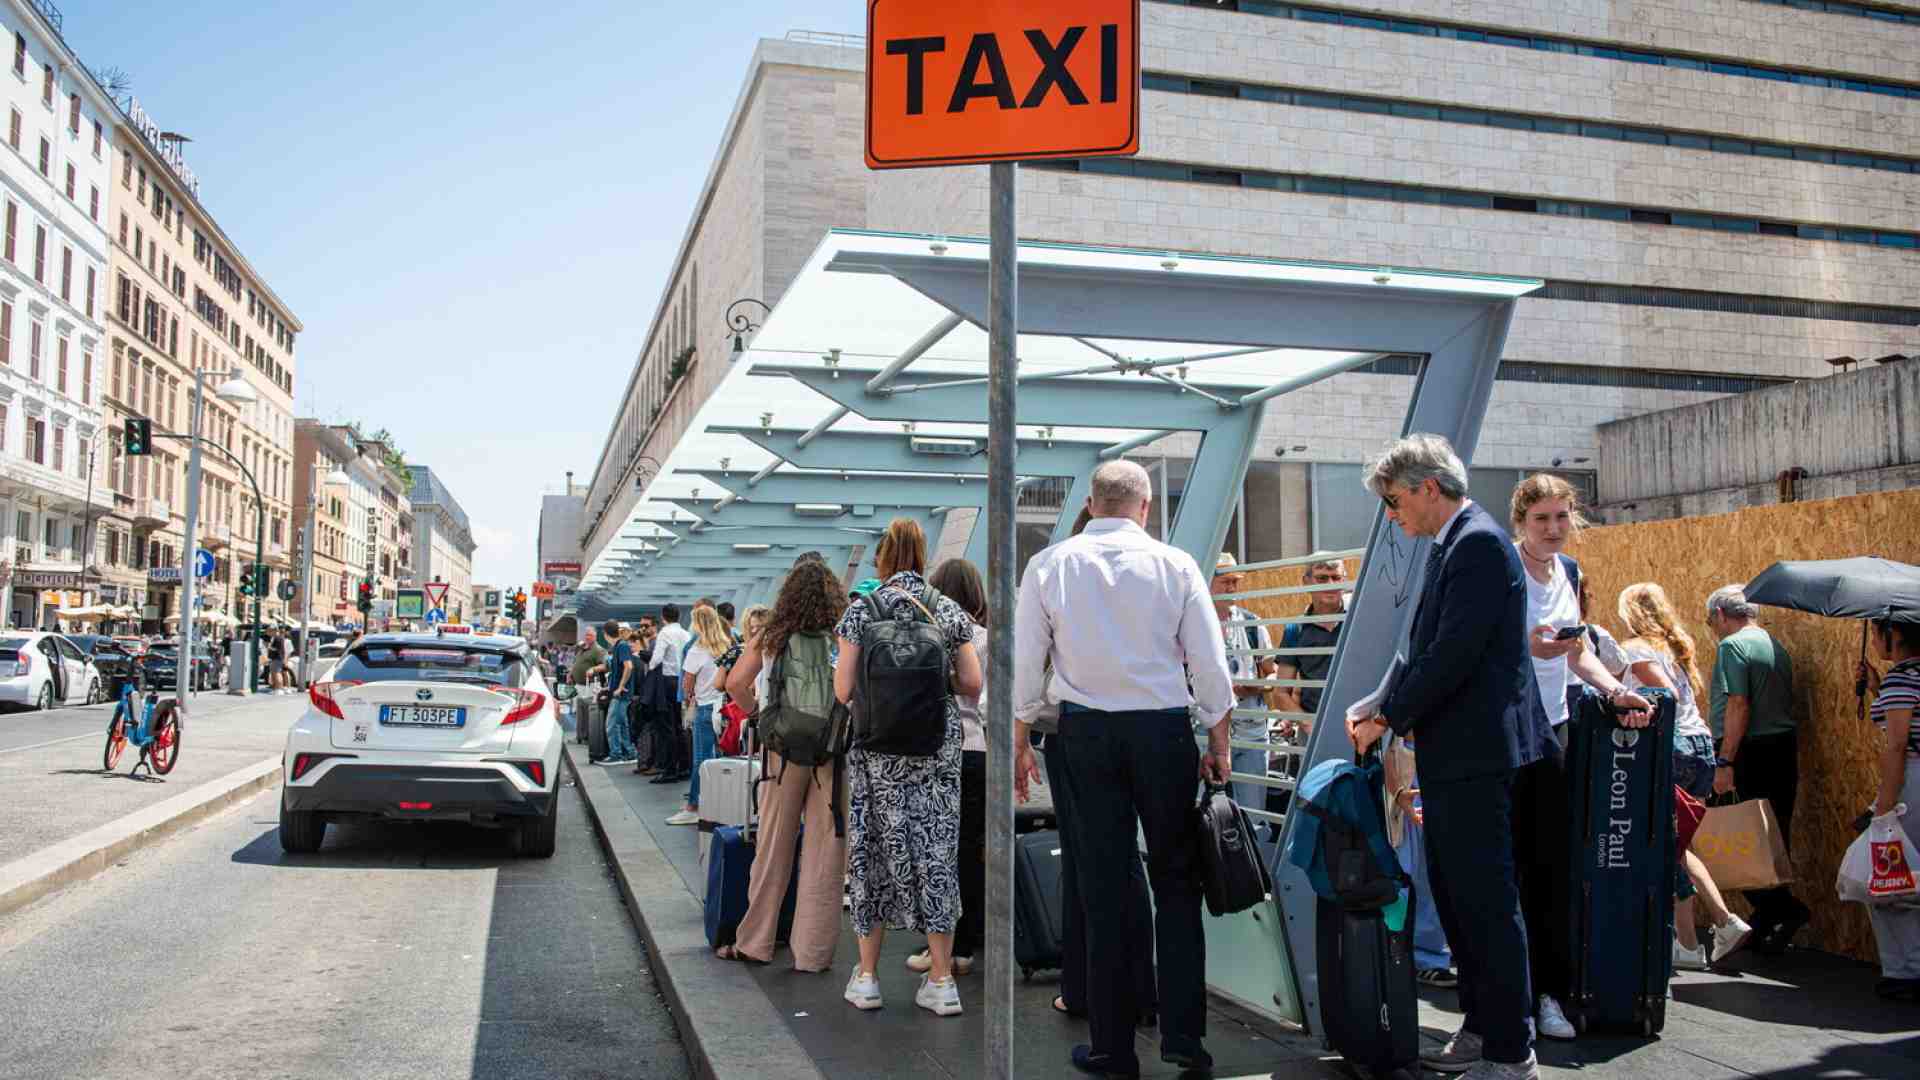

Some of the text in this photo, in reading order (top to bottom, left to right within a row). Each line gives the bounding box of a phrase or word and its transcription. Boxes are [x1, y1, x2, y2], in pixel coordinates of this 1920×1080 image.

[886, 23, 1118, 115] TAXI
[390, 708, 456, 723] FT 303PE
[1608, 752, 1636, 868] Leon Paul
[1597, 833, 1608, 868] London
